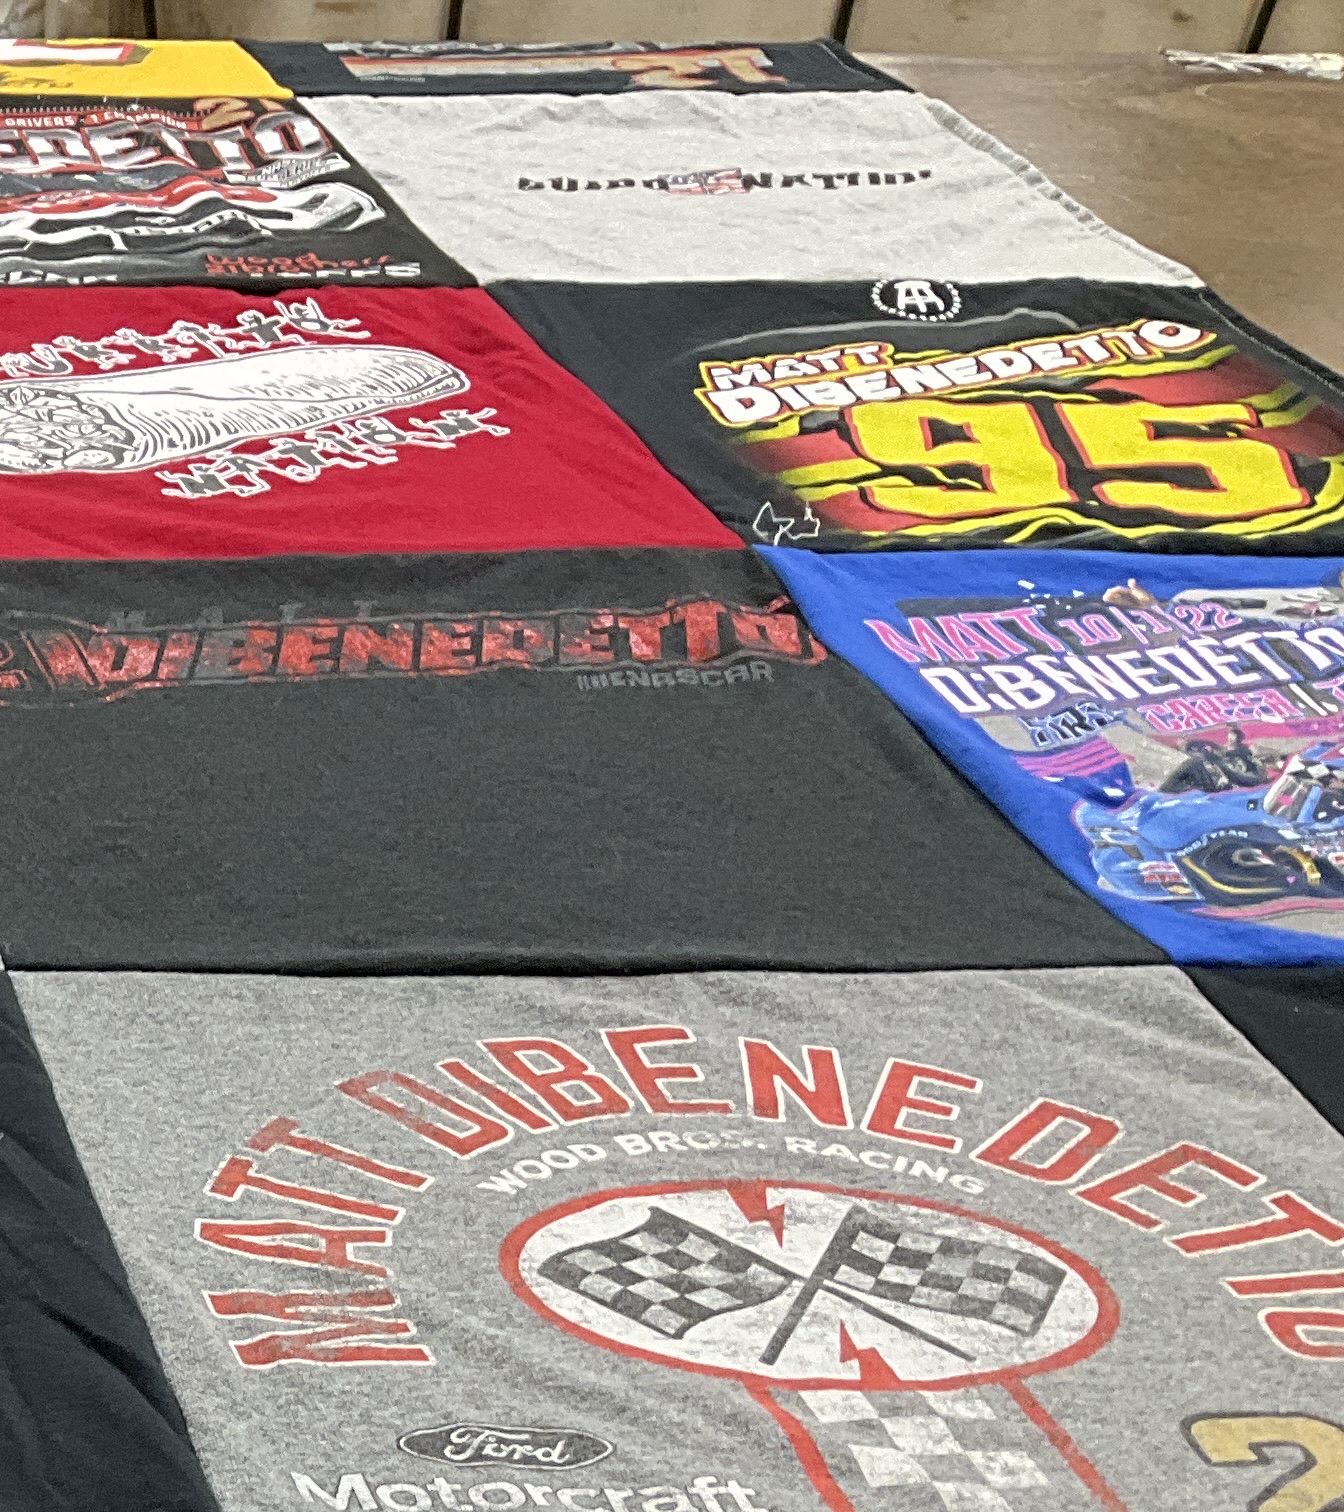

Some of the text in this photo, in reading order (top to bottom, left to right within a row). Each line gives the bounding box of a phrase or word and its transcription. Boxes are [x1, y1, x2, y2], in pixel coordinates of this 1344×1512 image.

[708, 319, 1208, 424] DIBENEDETTO
[710, 344, 886, 390] MATT
[843, 399, 1313, 518] 95
[864, 606, 1064, 664] MATT
[580, 661, 776, 690] NASCAR
[475, 1142, 608, 1198] WOOD
[785, 1135, 988, 1196] RACING
[442, 1424, 578, 1467] Ford
